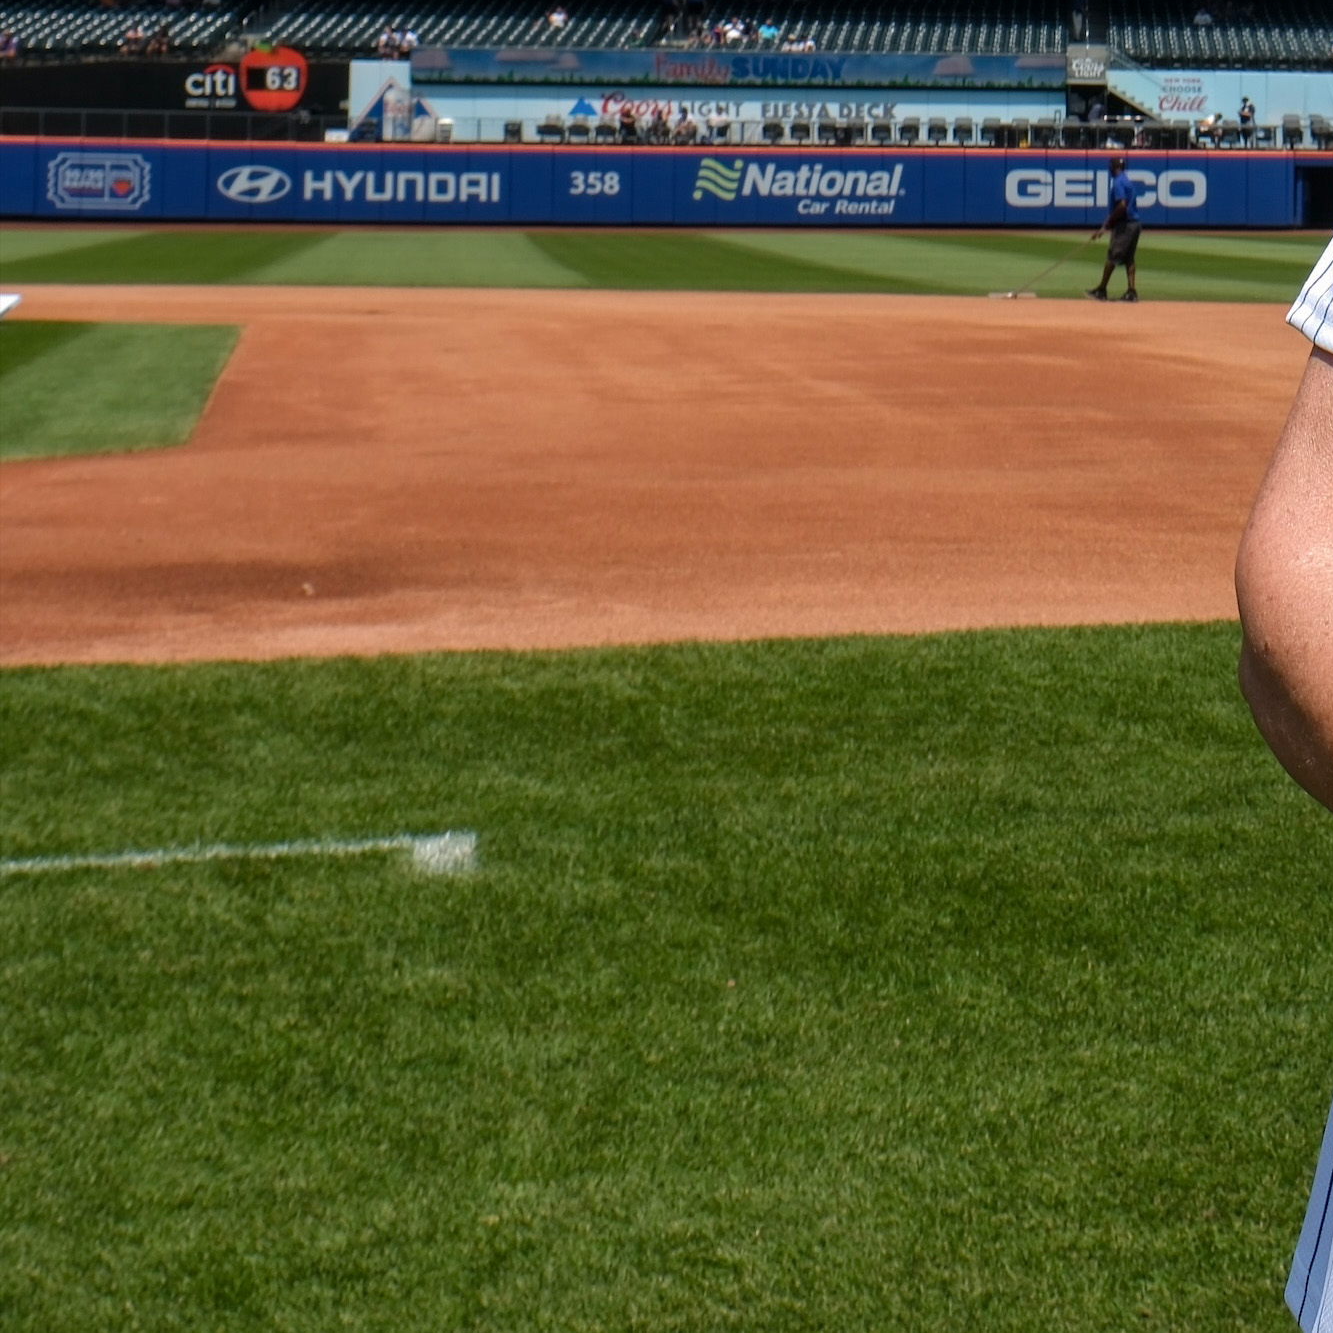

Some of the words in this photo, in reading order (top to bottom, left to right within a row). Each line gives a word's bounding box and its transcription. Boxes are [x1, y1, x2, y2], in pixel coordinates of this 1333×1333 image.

[265, 66, 299, 91] 63
[731, 56, 847, 80] SUNDAY
[184, 69, 237, 97] citi
[1162, 85, 1203, 94] CHOOSE
[600, 89, 673, 118] Coors
[761, 102, 832, 119] FIESTA
[838, 102, 898, 119] DECK
[1158, 94, 1208, 113] Chill
[303, 171, 501, 203] HYUNDAI
[568, 171, 620, 196] 358
[1005, 169, 1208, 208] GEICO
[798, 200, 830, 216] Car
[835, 198, 895, 216] Rental
